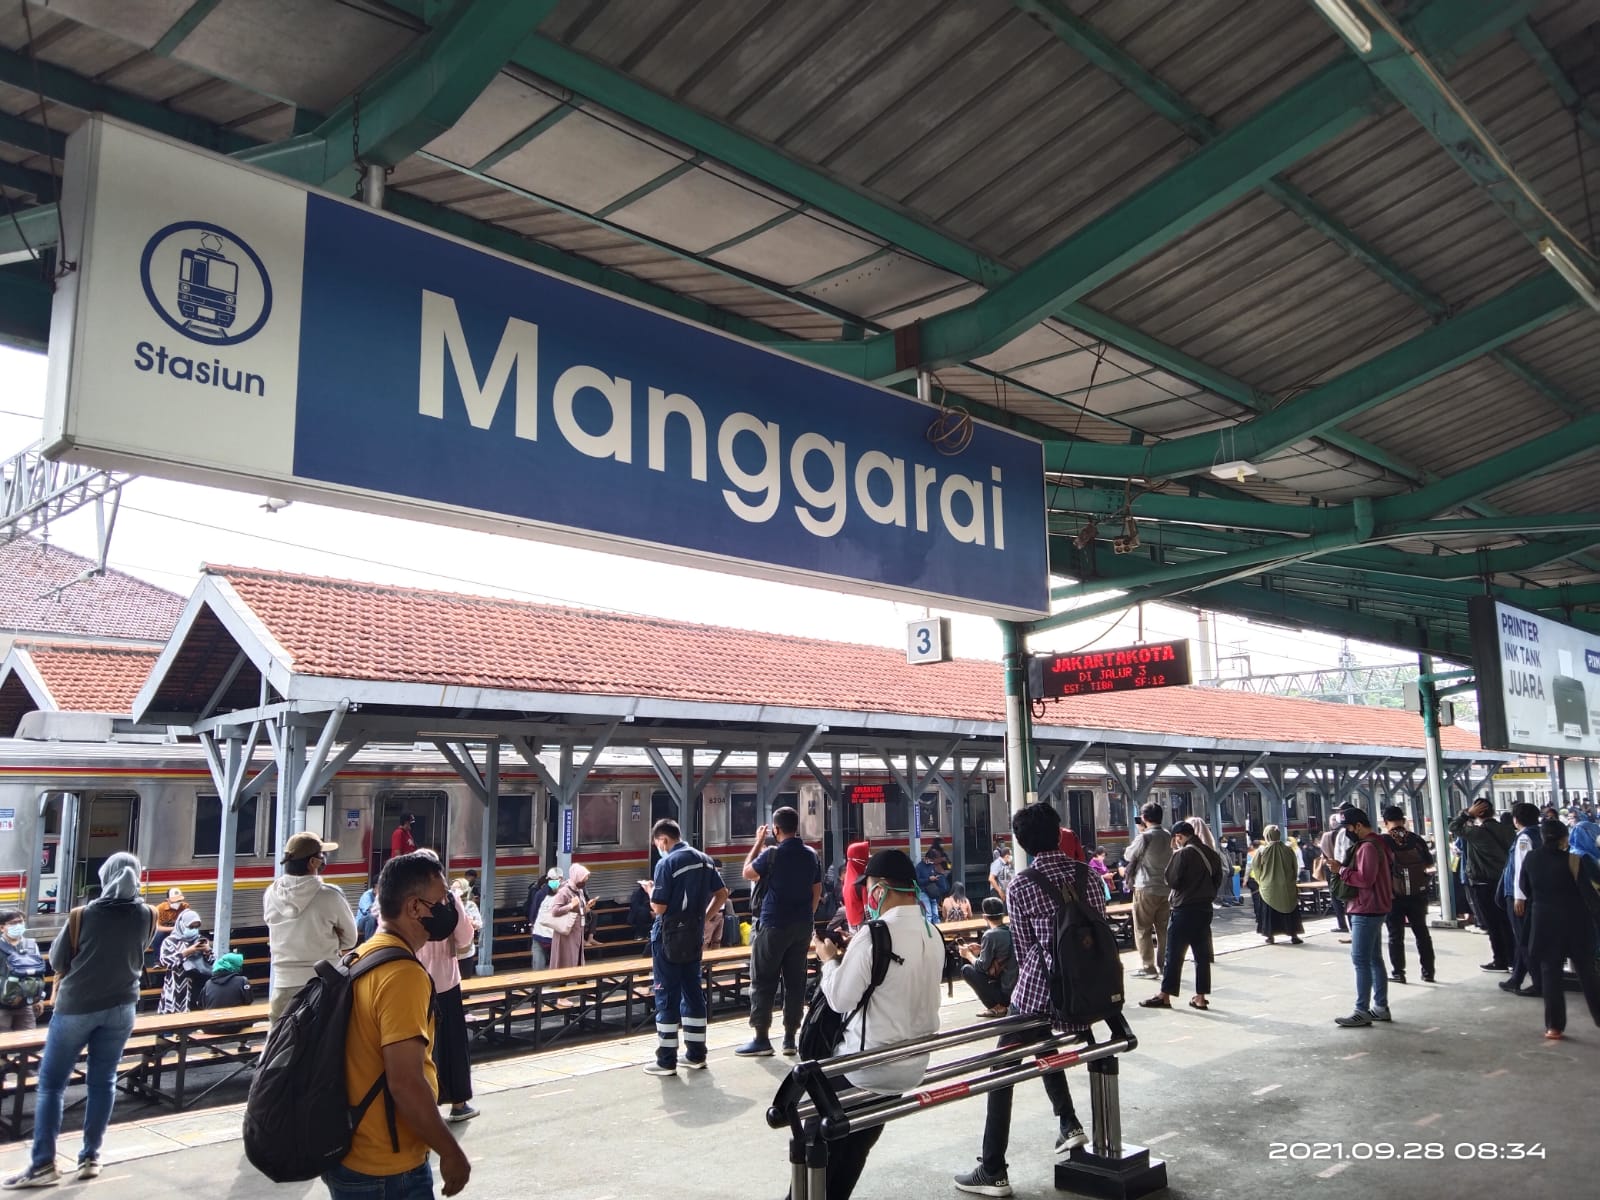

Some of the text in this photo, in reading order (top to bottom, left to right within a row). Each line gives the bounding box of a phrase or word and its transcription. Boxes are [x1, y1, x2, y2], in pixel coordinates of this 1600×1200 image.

[134, 341, 265, 397] Stasiun
[418, 288, 1005, 550] Manggarai
[1501, 612, 1539, 643] PRINTER
[917, 628, 931, 655] 3
[1504, 641, 1542, 668] INK TANK
[1052, 645, 1175, 672] JAKARTAKOTA
[1079, 671, 1092, 682] DI
[1100, 667, 1133, 680] JALUR
[1090, 680, 1114, 691] TIBA
[1508, 669, 1546, 701] JUARA
[1107, 779, 1113, 791] 3
